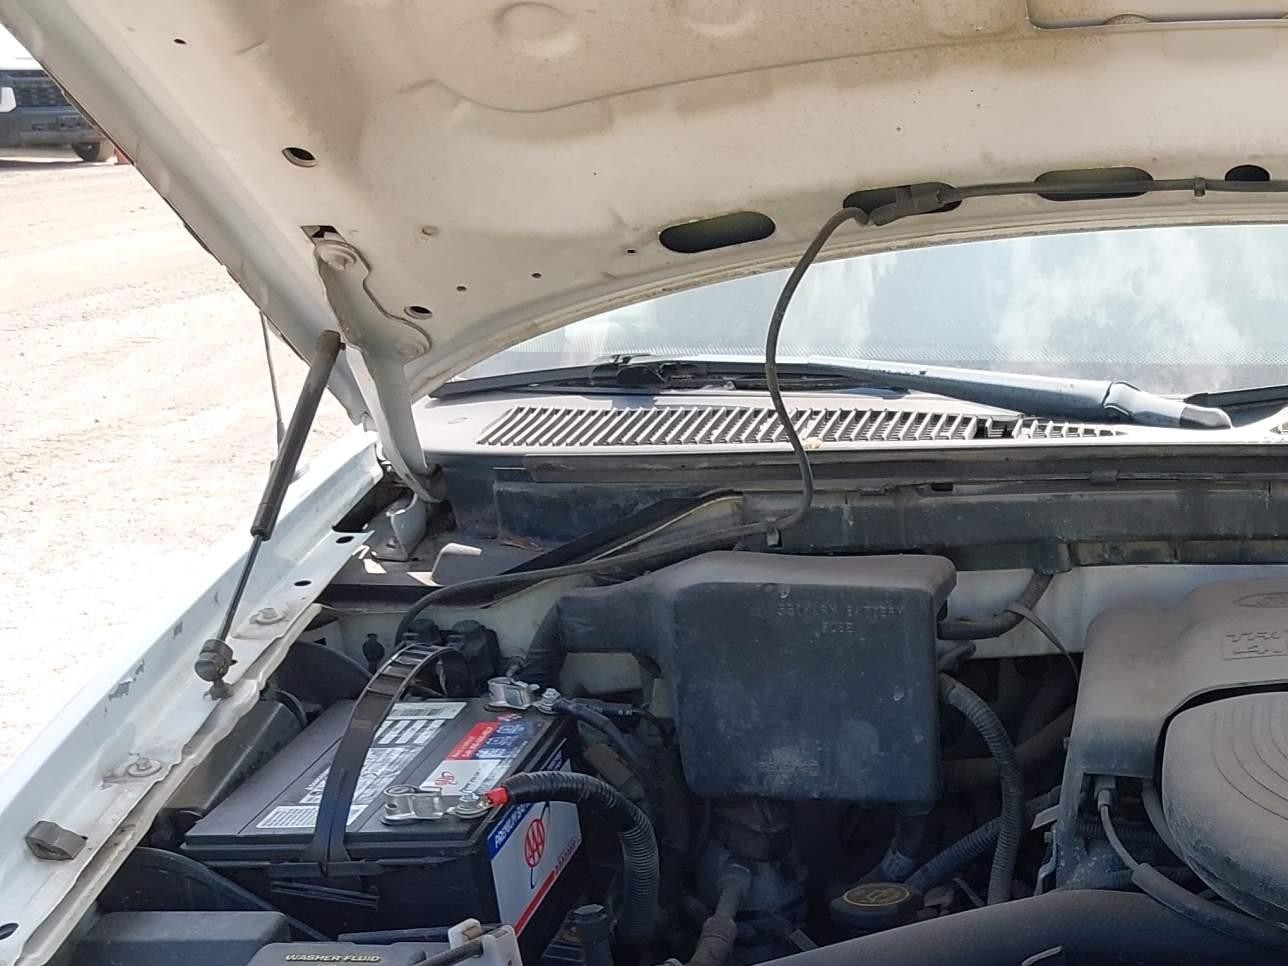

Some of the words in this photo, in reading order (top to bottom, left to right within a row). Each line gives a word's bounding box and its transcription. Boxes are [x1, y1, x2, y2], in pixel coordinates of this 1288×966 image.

[524, 818, 546, 868] AAA
[285, 953, 341, 962] WASHER
[343, 954, 381, 963] FLUID
